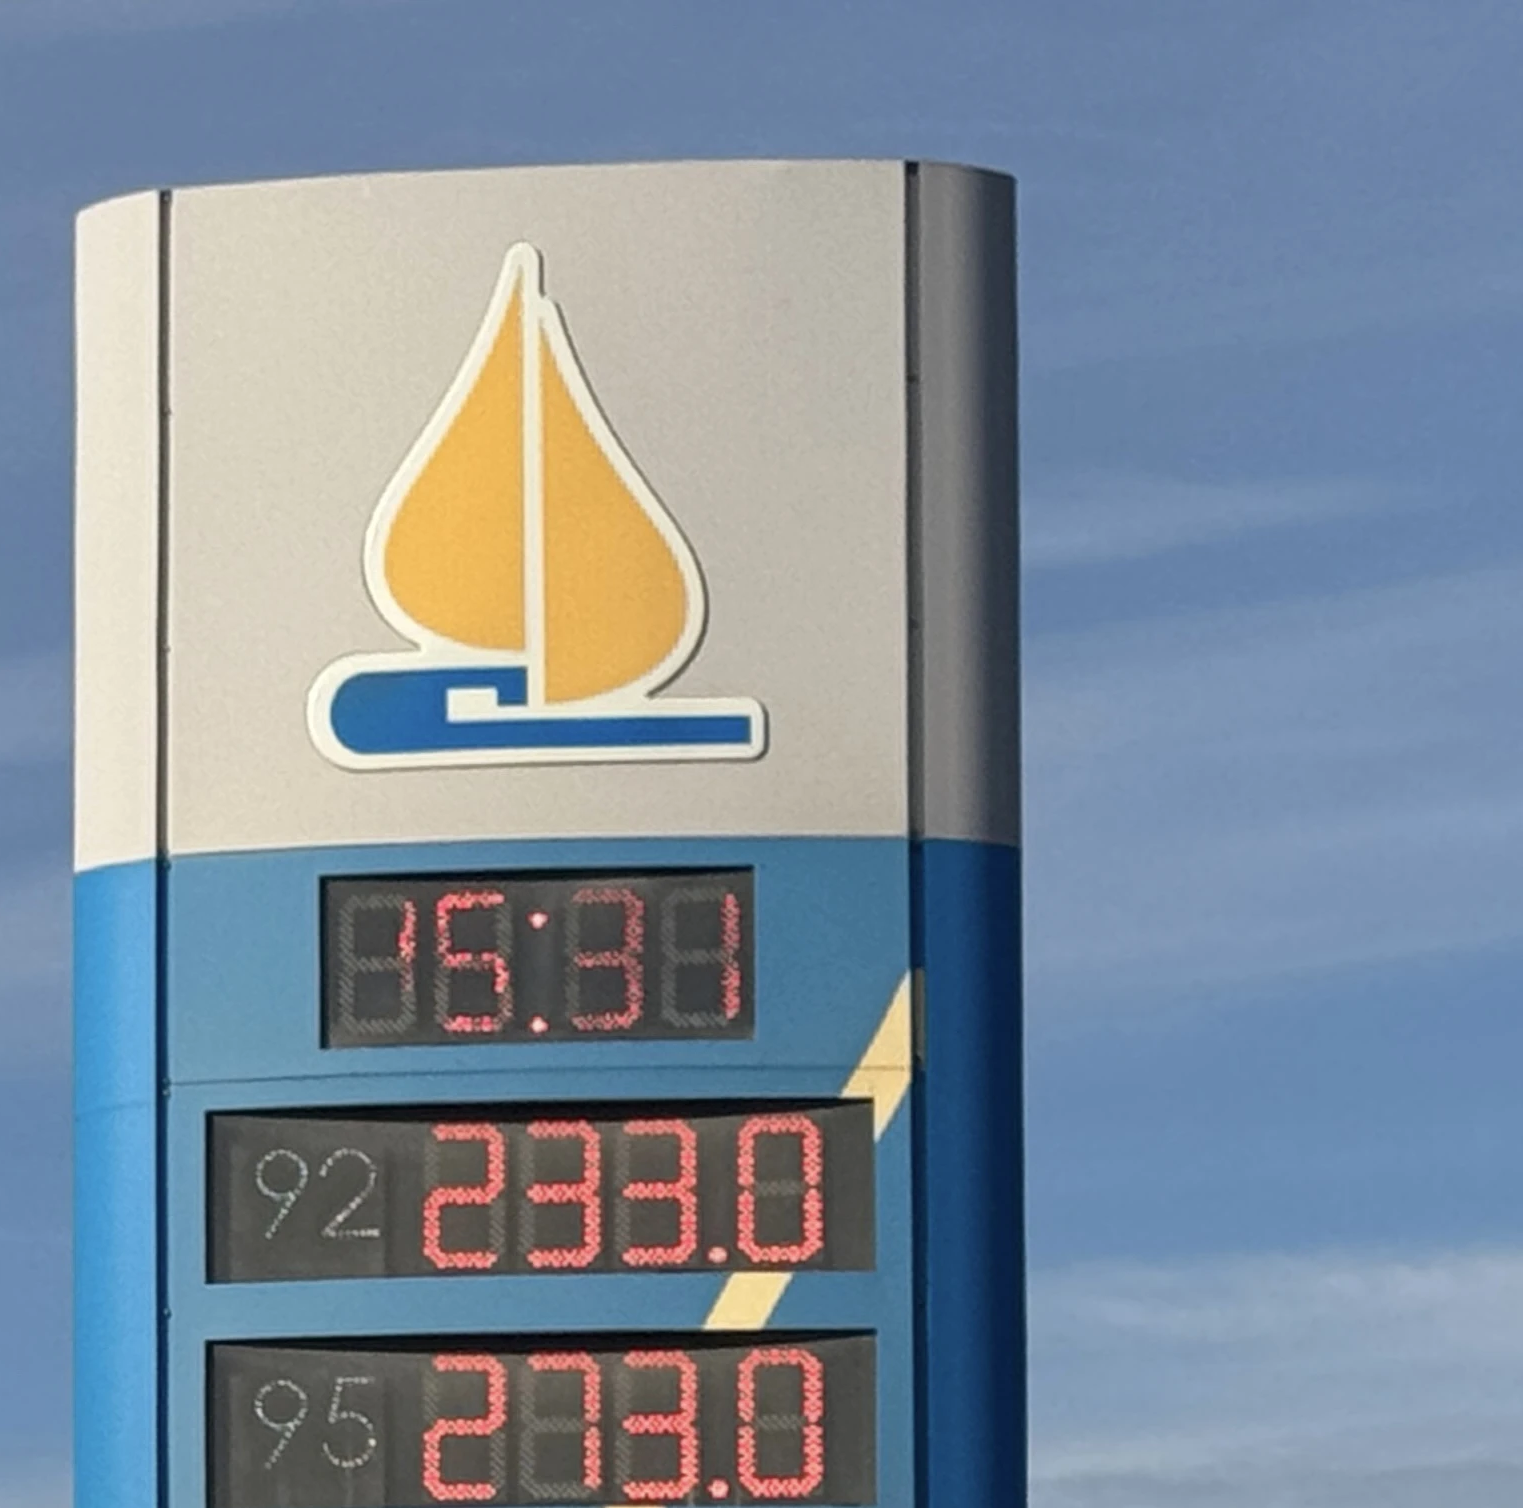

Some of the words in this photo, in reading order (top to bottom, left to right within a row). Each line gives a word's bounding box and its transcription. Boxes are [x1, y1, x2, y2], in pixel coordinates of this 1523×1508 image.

[398, 890, 742, 1034] 15:31
[254, 1146, 382, 1242] 92
[422, 1115, 825, 1270] 233.0
[254, 1375, 379, 1471] 95
[422, 1348, 825, 1504] 273.0
